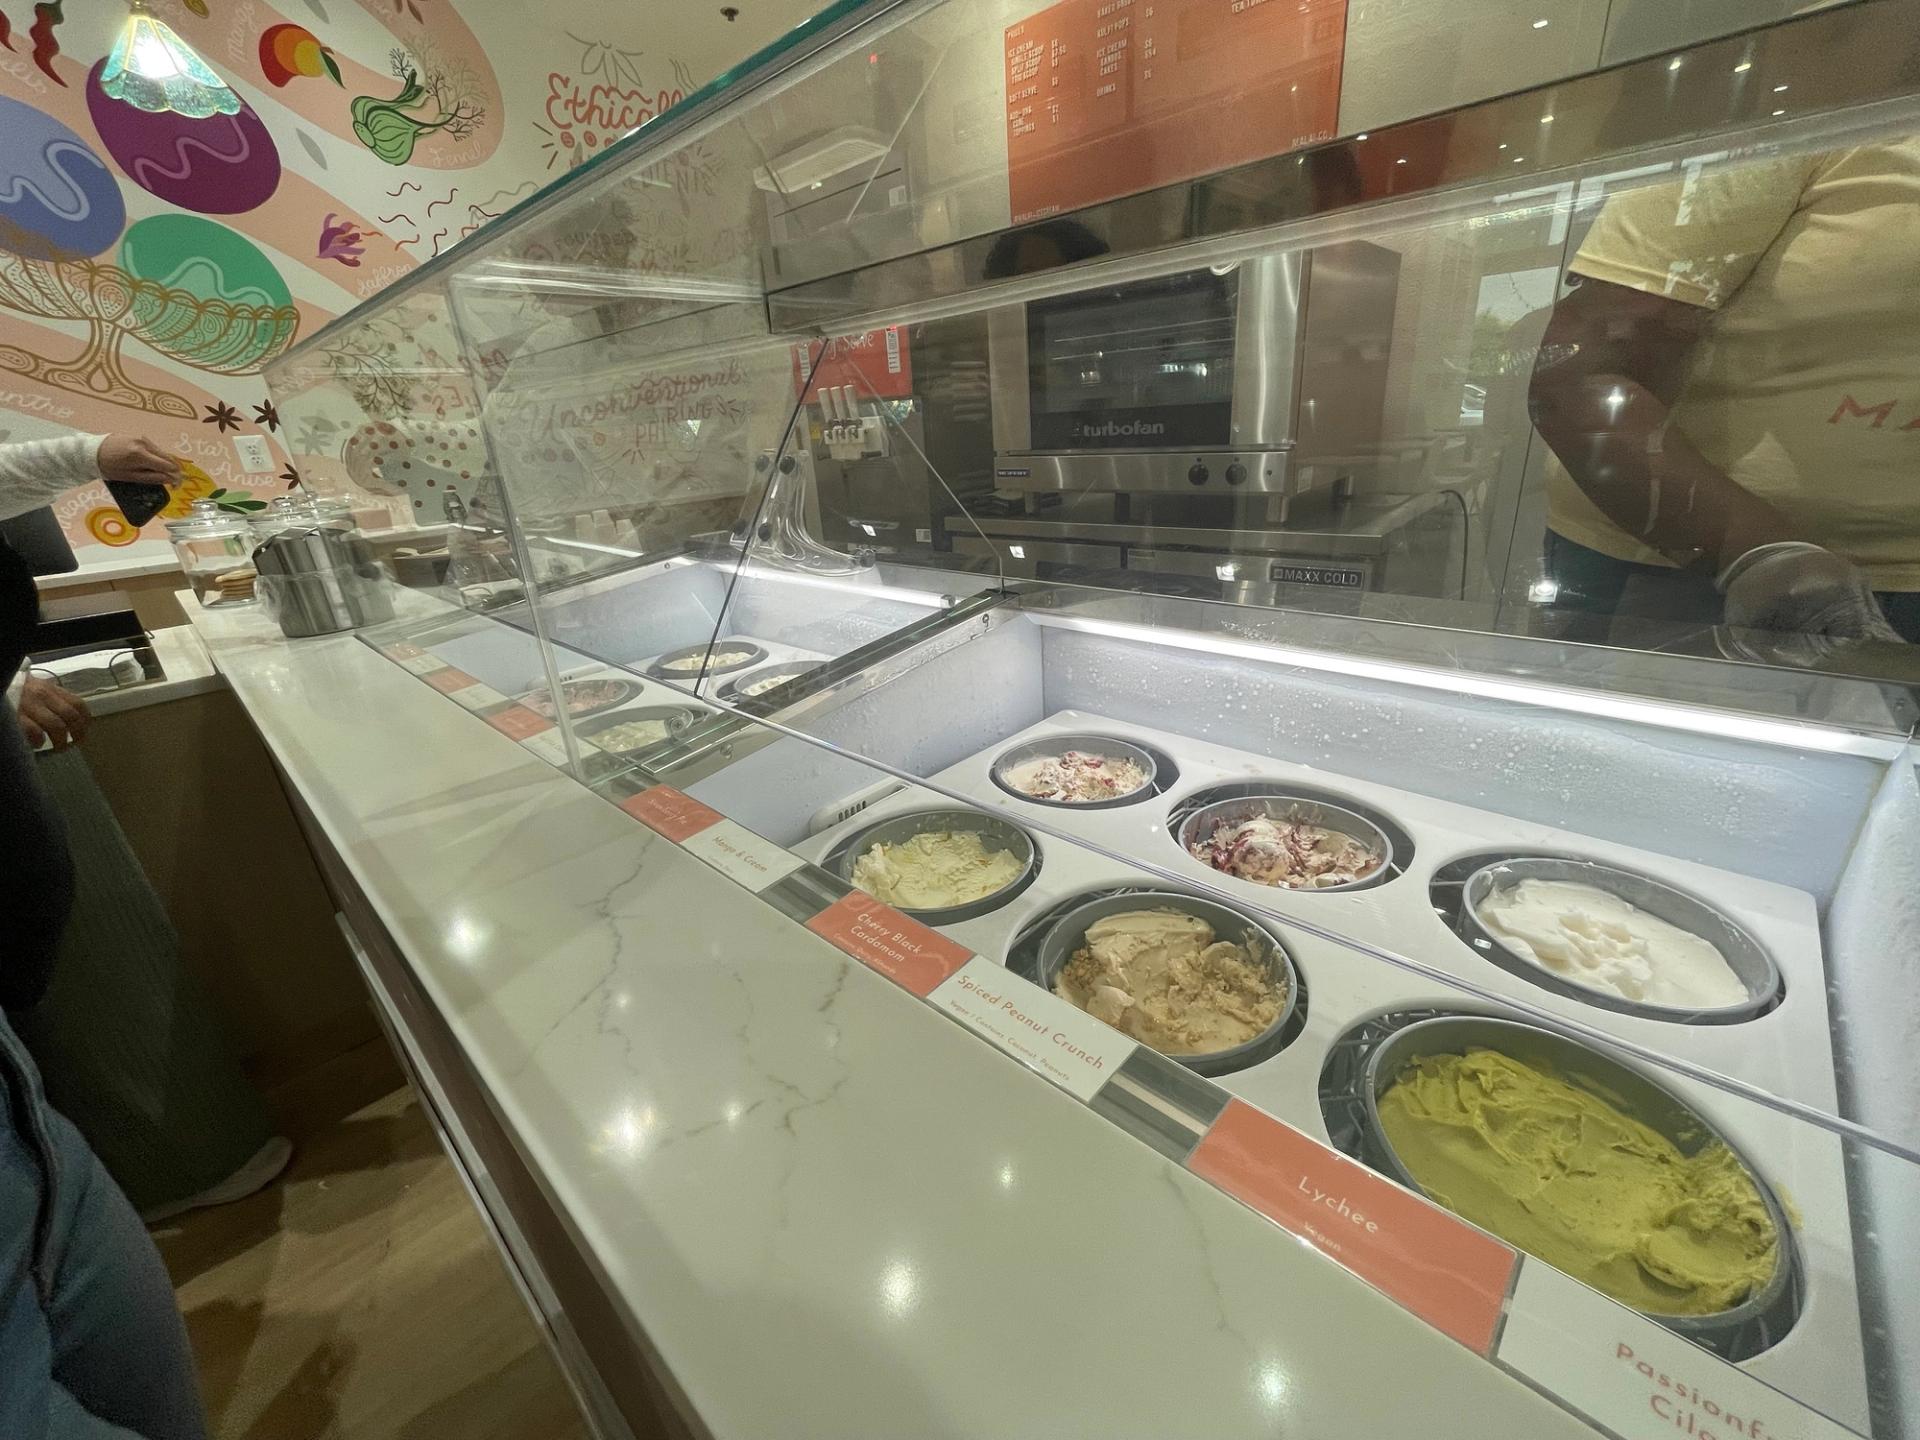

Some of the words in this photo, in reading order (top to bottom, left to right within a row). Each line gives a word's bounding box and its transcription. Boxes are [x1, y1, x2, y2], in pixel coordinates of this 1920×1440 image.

[1106, 38, 1127, 53] CREAM
[1083, 419, 1164, 437] turbofan
[174, 432, 231, 460] Star
[208, 461, 275, 488] Anise
[1284, 568, 1320, 583] MAXX
[1323, 572, 1358, 585] COLD
[850, 925, 905, 962] Cardamom
[857, 913, 891, 937] Cherry
[891, 932, 924, 955] Black
[957, 974, 1002, 1005] Spiced
[1001, 1001, 1049, 1035] Peanut
[1052, 1032, 1104, 1069] Crunch
[1040, 1057, 1071, 1081] Peanuts
[1298, 1175, 1379, 1233] Lychee
[1303, 1221, 1342, 1252] Vegan
[1616, 1342, 1775, 1440] Passionf
